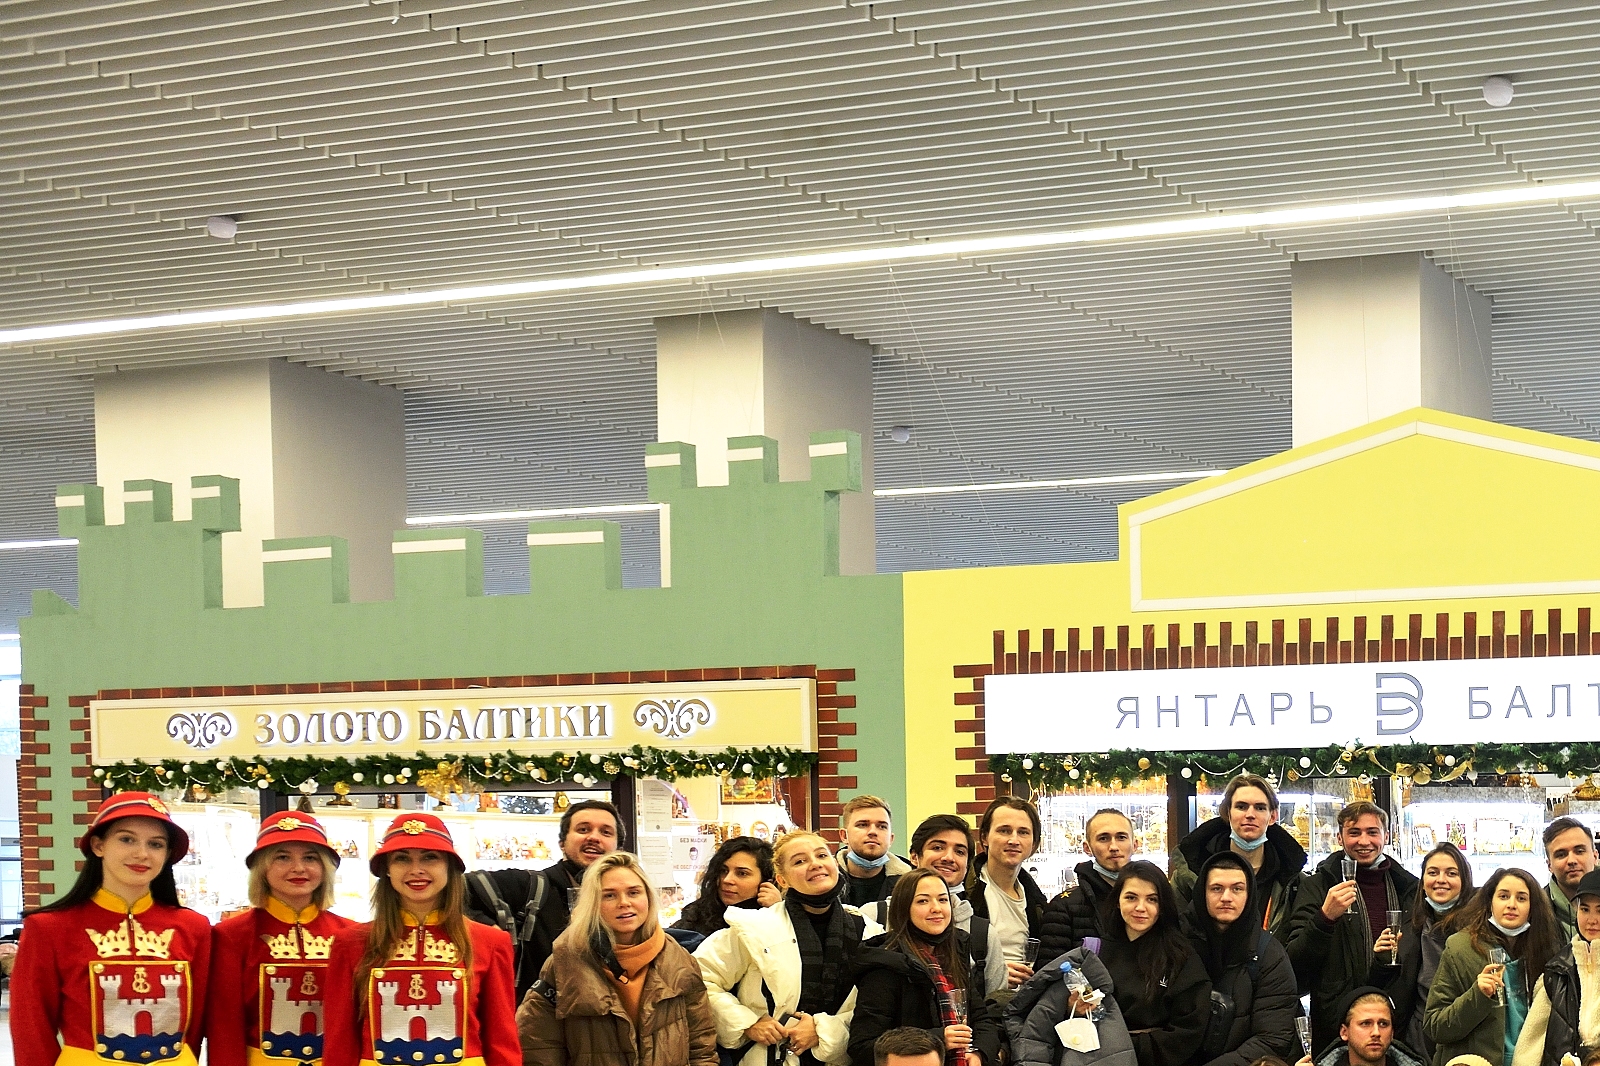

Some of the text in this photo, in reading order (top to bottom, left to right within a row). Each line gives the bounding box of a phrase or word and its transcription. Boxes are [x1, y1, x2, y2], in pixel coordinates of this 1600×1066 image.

[252, 704, 612, 745] ЗОЛОТО БАЛТИКИ
[1115, 691, 1333, 729] ЯНТАРЬ
